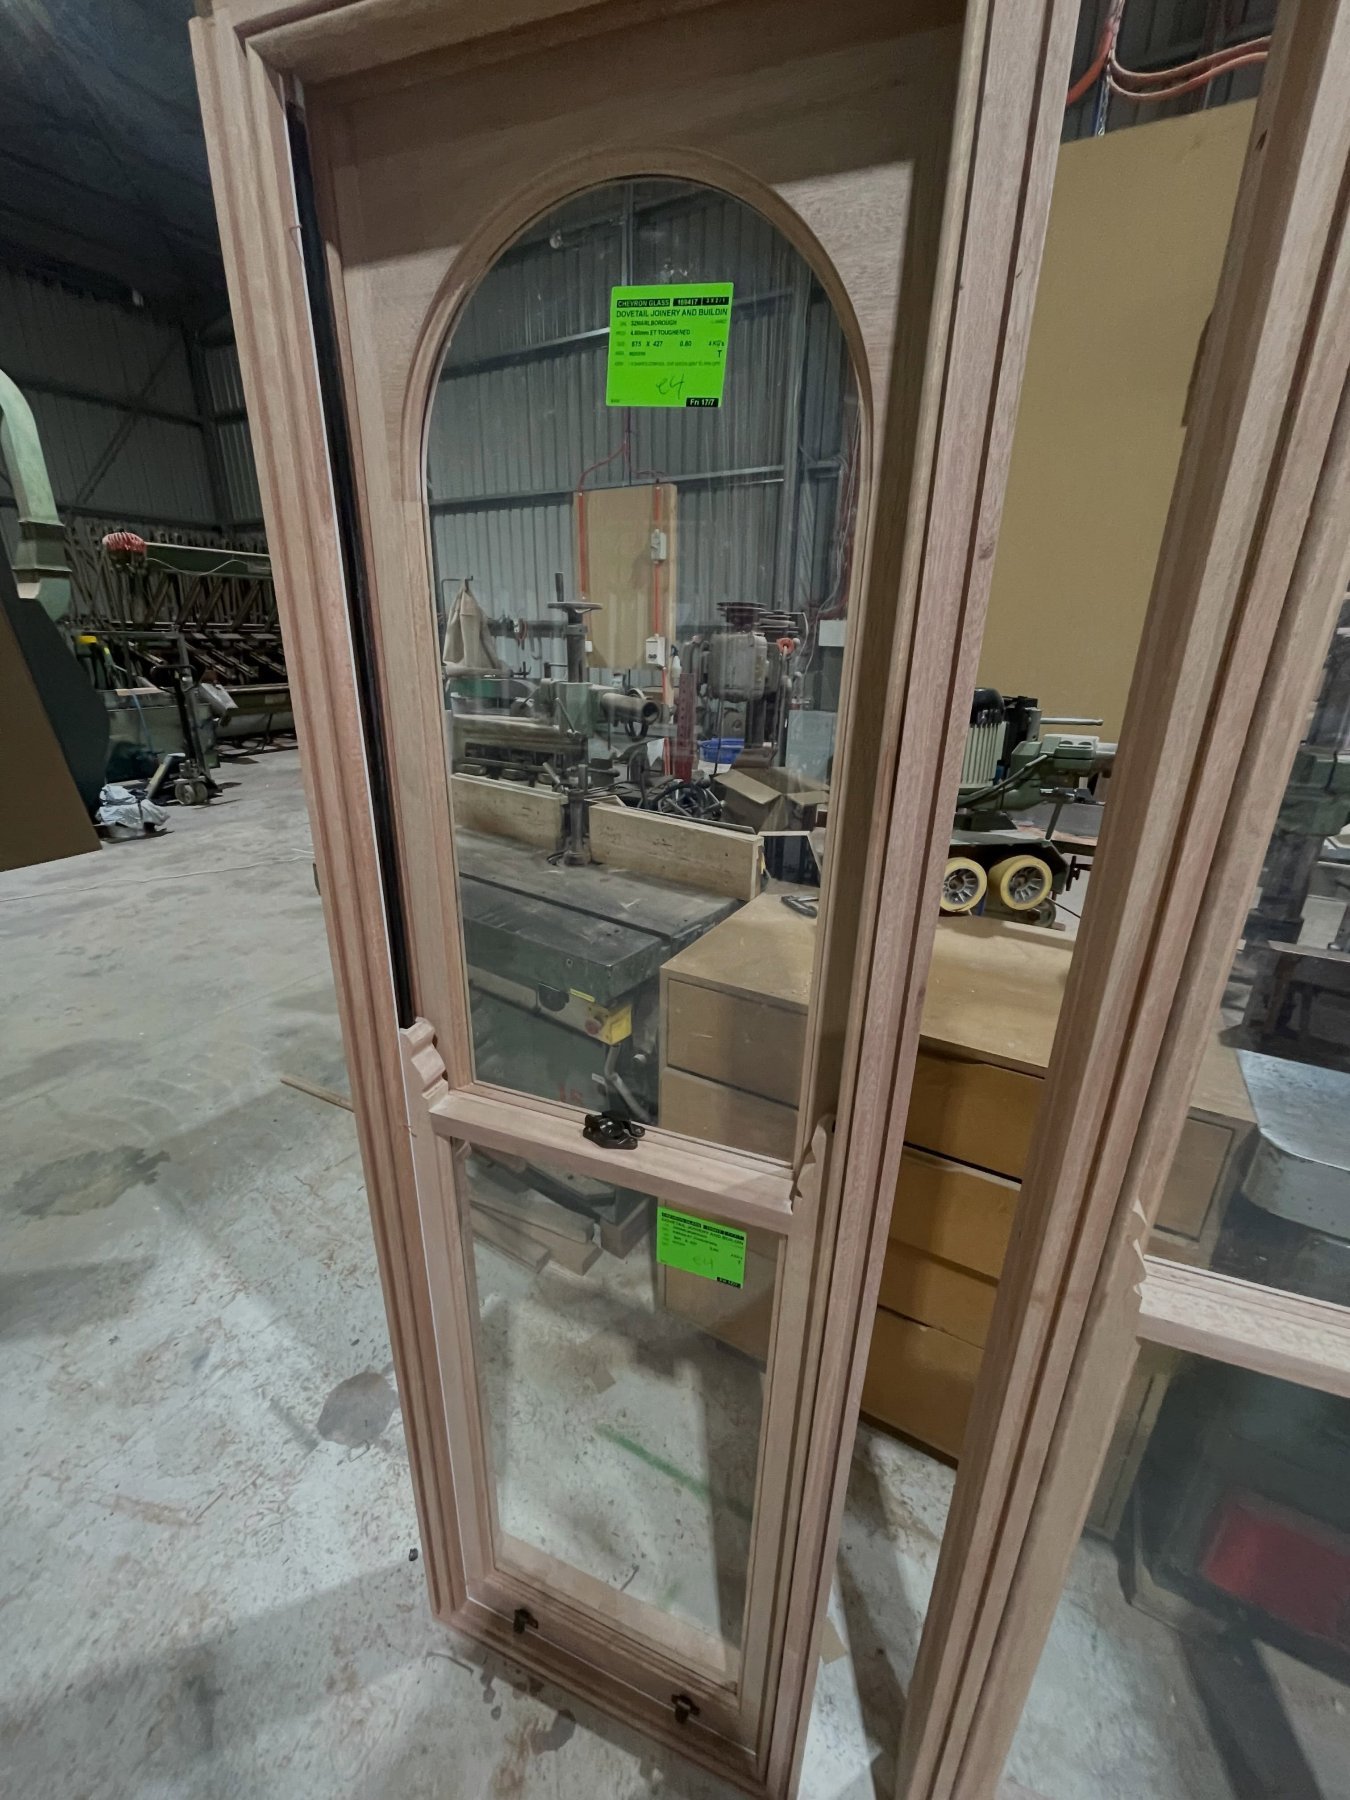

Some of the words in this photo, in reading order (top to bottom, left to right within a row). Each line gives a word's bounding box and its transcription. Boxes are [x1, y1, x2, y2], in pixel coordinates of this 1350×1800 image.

[616, 310, 648, 318] DOVETAIL
[650, 309, 680, 317] JOINERY
[699, 308, 728, 316] BUILDIN
[717, 350, 722, 358] T
